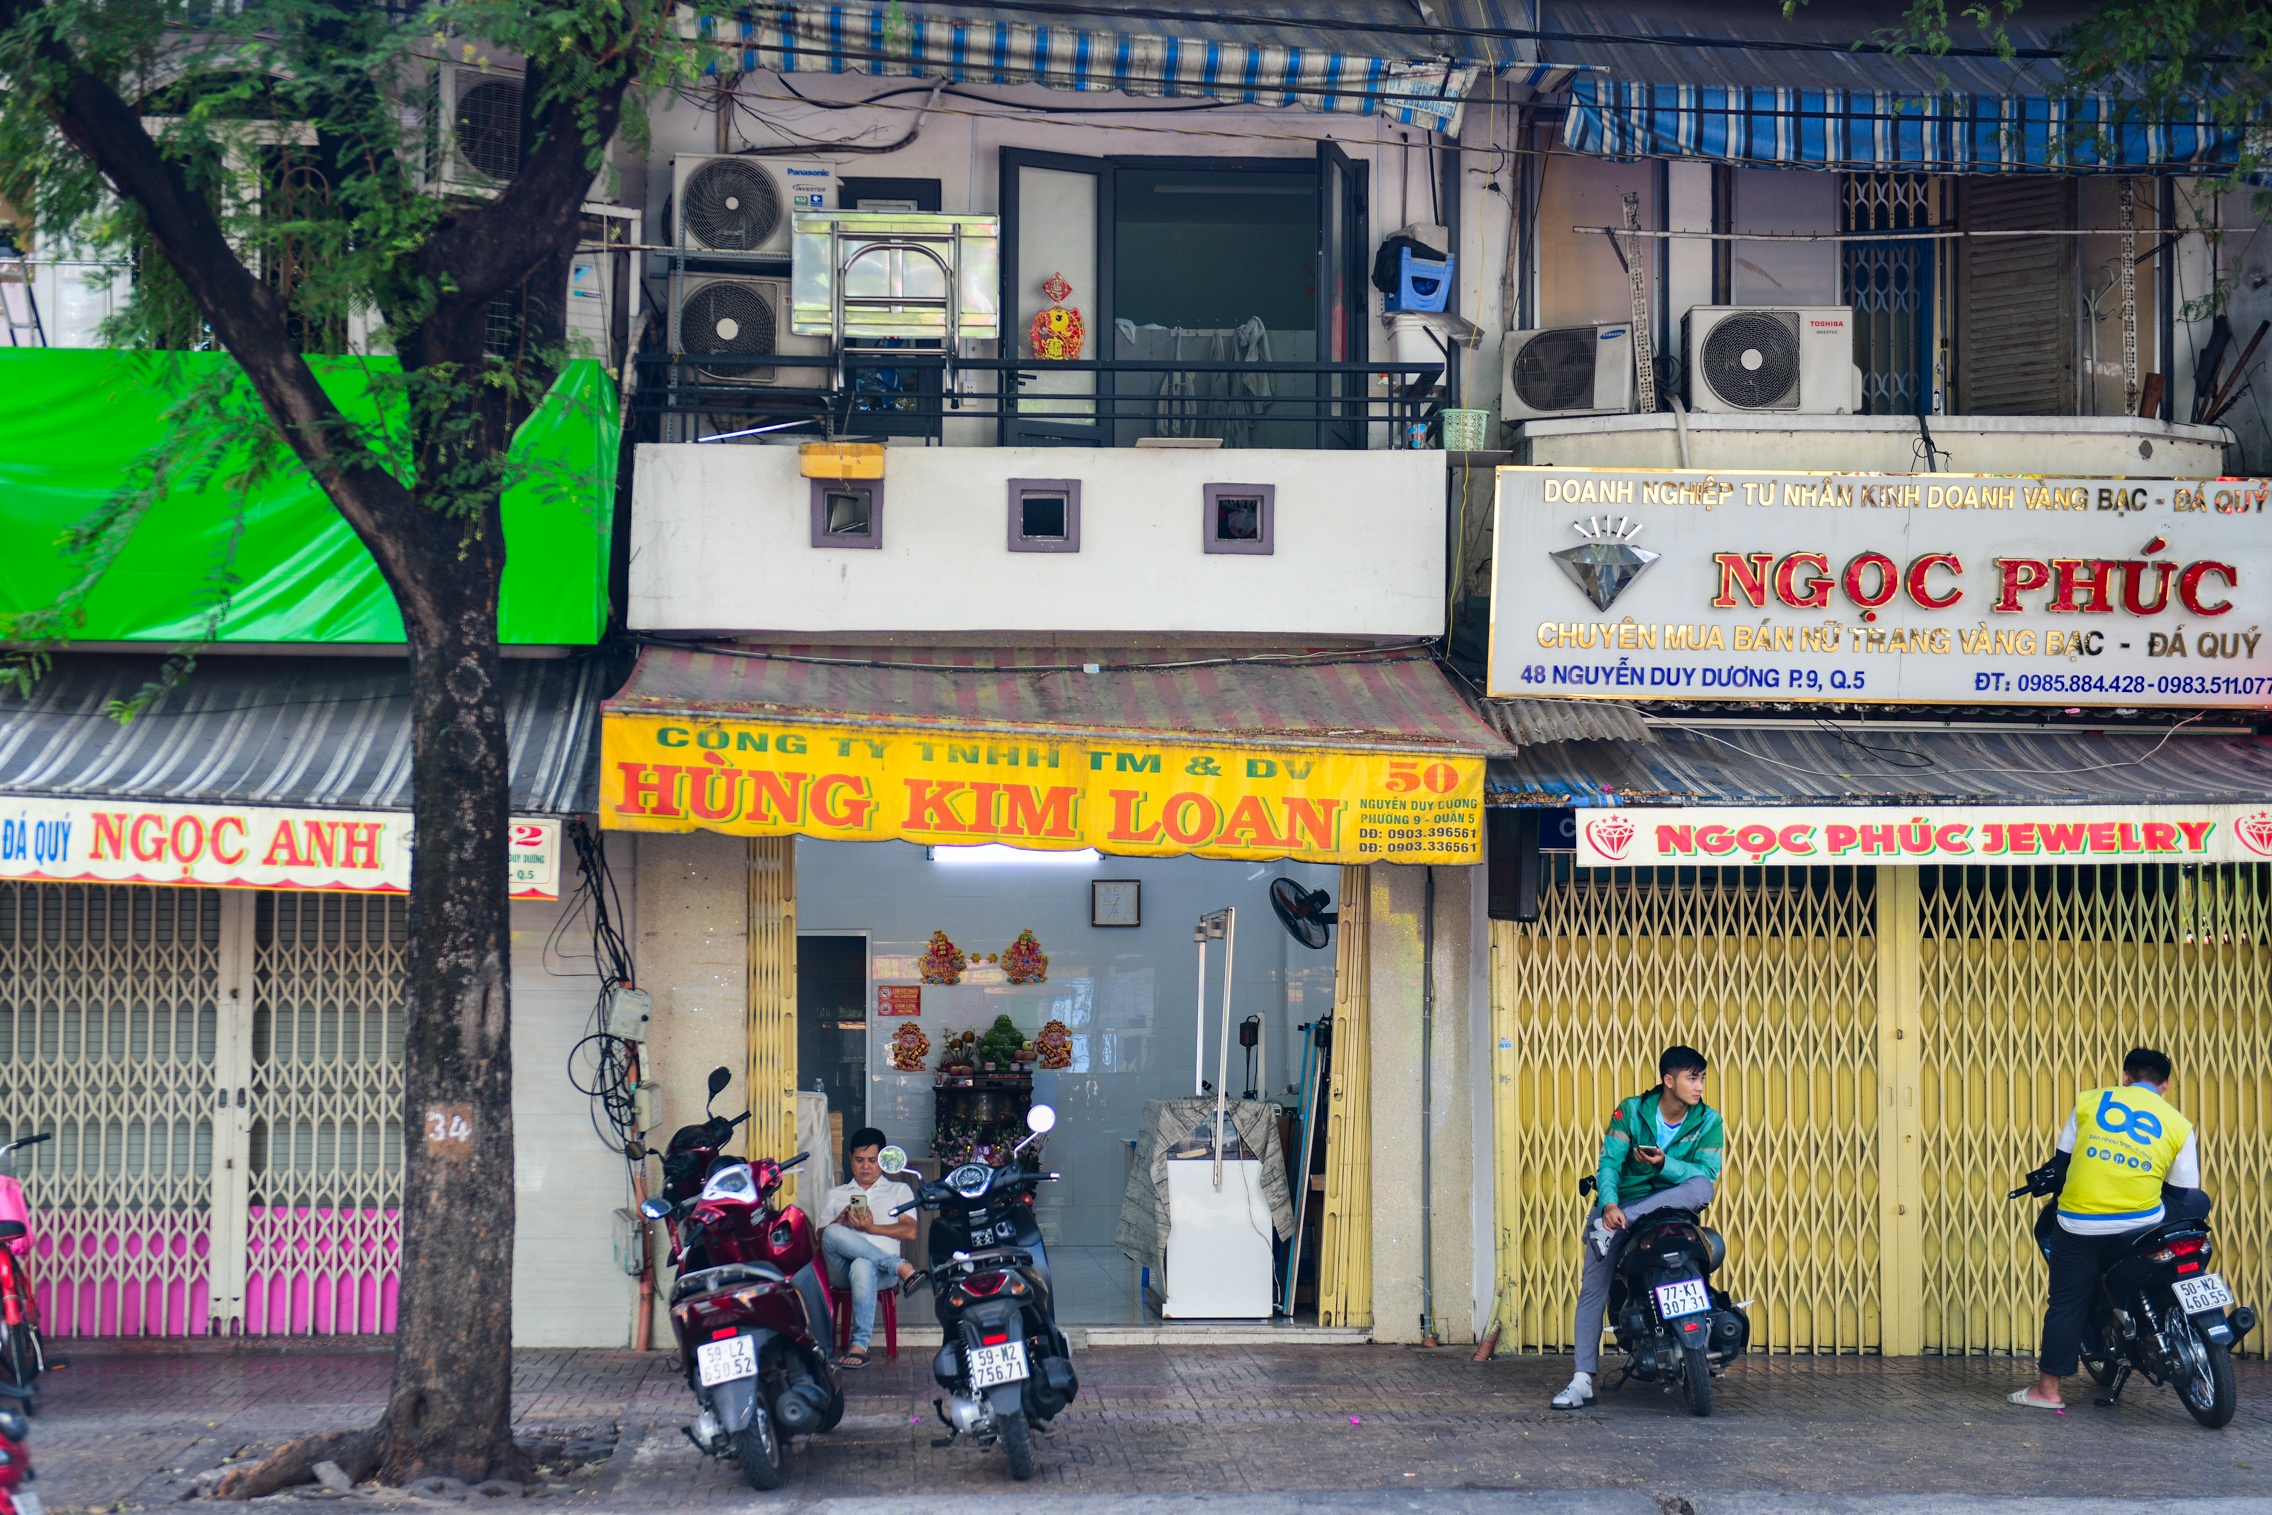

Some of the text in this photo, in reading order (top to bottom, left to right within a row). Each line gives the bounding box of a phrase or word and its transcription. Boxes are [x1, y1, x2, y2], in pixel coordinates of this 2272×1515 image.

[787, 168, 829, 177] Panasonic
[1544, 478, 1633, 503] DOANH
[1642, 475, 1733, 511] NGHIỆP
[1784, 477, 1852, 508] NHÂN
[1862, 483, 1920, 509] KINH
[1927, 485, 2015, 510] DOANH
[2023, 479, 2088, 511] VÀNG
[2097, 487, 2147, 517] BẠC
[2173, 481, 2207, 512] ĐÁ
[2215, 482, 2270, 514] QUÝ
[1711, 536, 2238, 623] NGỌC PHÚC
[1536, 616, 1656, 650] CHUYÊN
[1664, 624, 1725, 651] MUA
[1733, 618, 1794, 652] BÁN
[1848, 627, 1950, 655] TRANG
[1959, 621, 2036, 656] VÀNG
[2045, 630, 2105, 662] BẠC
[2148, 624, 2187, 658] ĐÁ
[2197, 625, 2262, 659] QUÝ
[1520, 665, 1546, 684] 48
[1552, 657, 1645, 686] NGUYỄN
[1650, 667, 1697, 686] DUY
[1702, 666, 1780, 688] DƯƠNG
[1830, 669, 1865, 691] Q.5
[1975, 672, 2011, 692] ĐT:
[656, 724, 1317, 780] CÔNG TY TNHH TM & DV
[1385, 760, 1459, 794] 50
[616, 751, 1348, 852] HÙNG KIM LOAN
[1411, 800, 1434, 811] DUY
[1413, 816, 1421, 824] 9
[1434, 810, 1465, 825] QUẬN
[1468, 813, 1475, 824] 5
[3, 810, 384, 876] ĐÁ QUÝ NGỌC ANH
[508, 825, 542, 846] 2
[1388, 827, 1476, 839] 0903.396561
[1655, 816, 2216, 864] NGỌC PHÚC JEWELRY
[1388, 841, 1476, 853] 0903.336561
[517, 870, 534, 880] Q.5
[425, 1111, 472, 1142] 34
[2096, 1091, 2162, 1145] be
[1663, 1283, 1697, 1301] 77-K1
[2180, 1277, 2218, 1297] 50-N2
[1663, 1295, 1705, 1316] 307.31
[2185, 1290, 2228, 1310] 460.55
[706, 1341, 745, 1364] 59-L2
[978, 1345, 1017, 1366] 59-M2
[704, 1357, 753, 1382] 650.52
[978, 1361, 1024, 1384] 756.71
